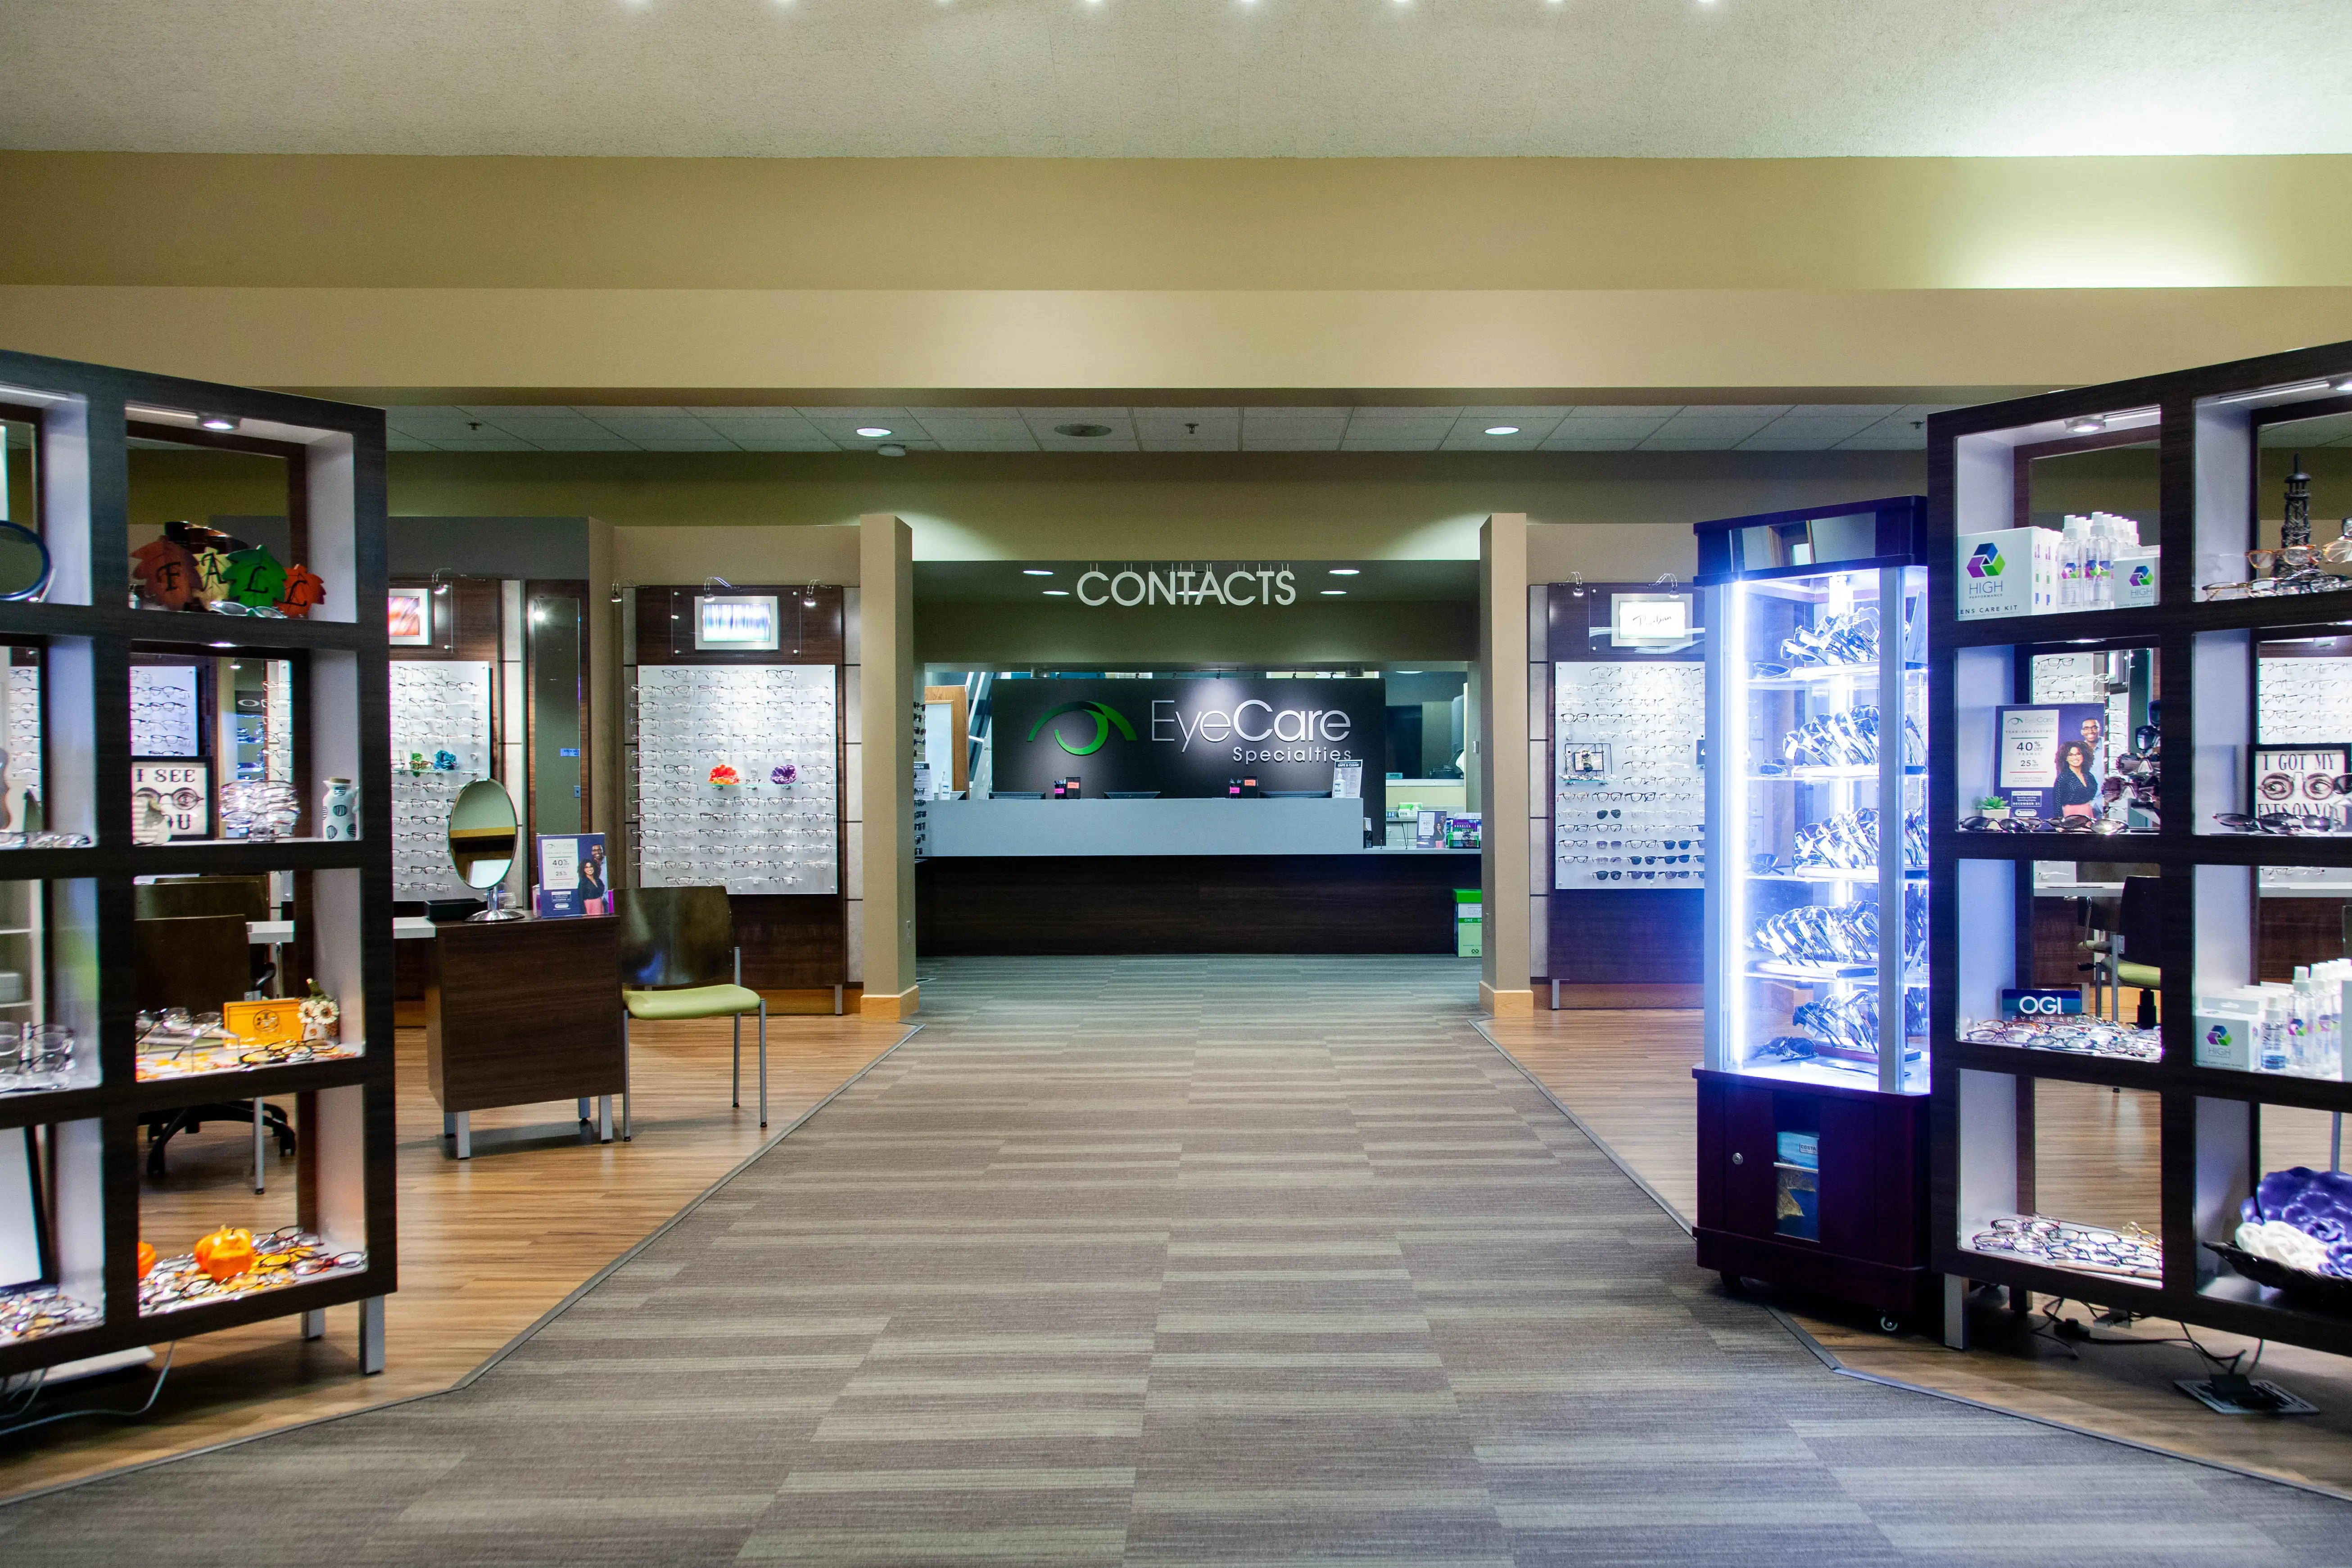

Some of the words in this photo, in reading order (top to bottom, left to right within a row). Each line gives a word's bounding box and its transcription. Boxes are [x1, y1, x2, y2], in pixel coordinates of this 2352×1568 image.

[1077, 571, 1296, 606] CONTACTS
[1969, 580, 2003, 595] HIGH
[2130, 587, 2153, 596] HIGH
[1152, 699, 1351, 753] EyeCare
[1233, 746, 1351, 764] Specialties
[2263, 754, 2268, 770] I
[2279, 754, 2307, 770] GOT
[2314, 753, 2336, 770] MY
[135, 768, 144, 782] I
[154, 768, 195, 783] SEE
